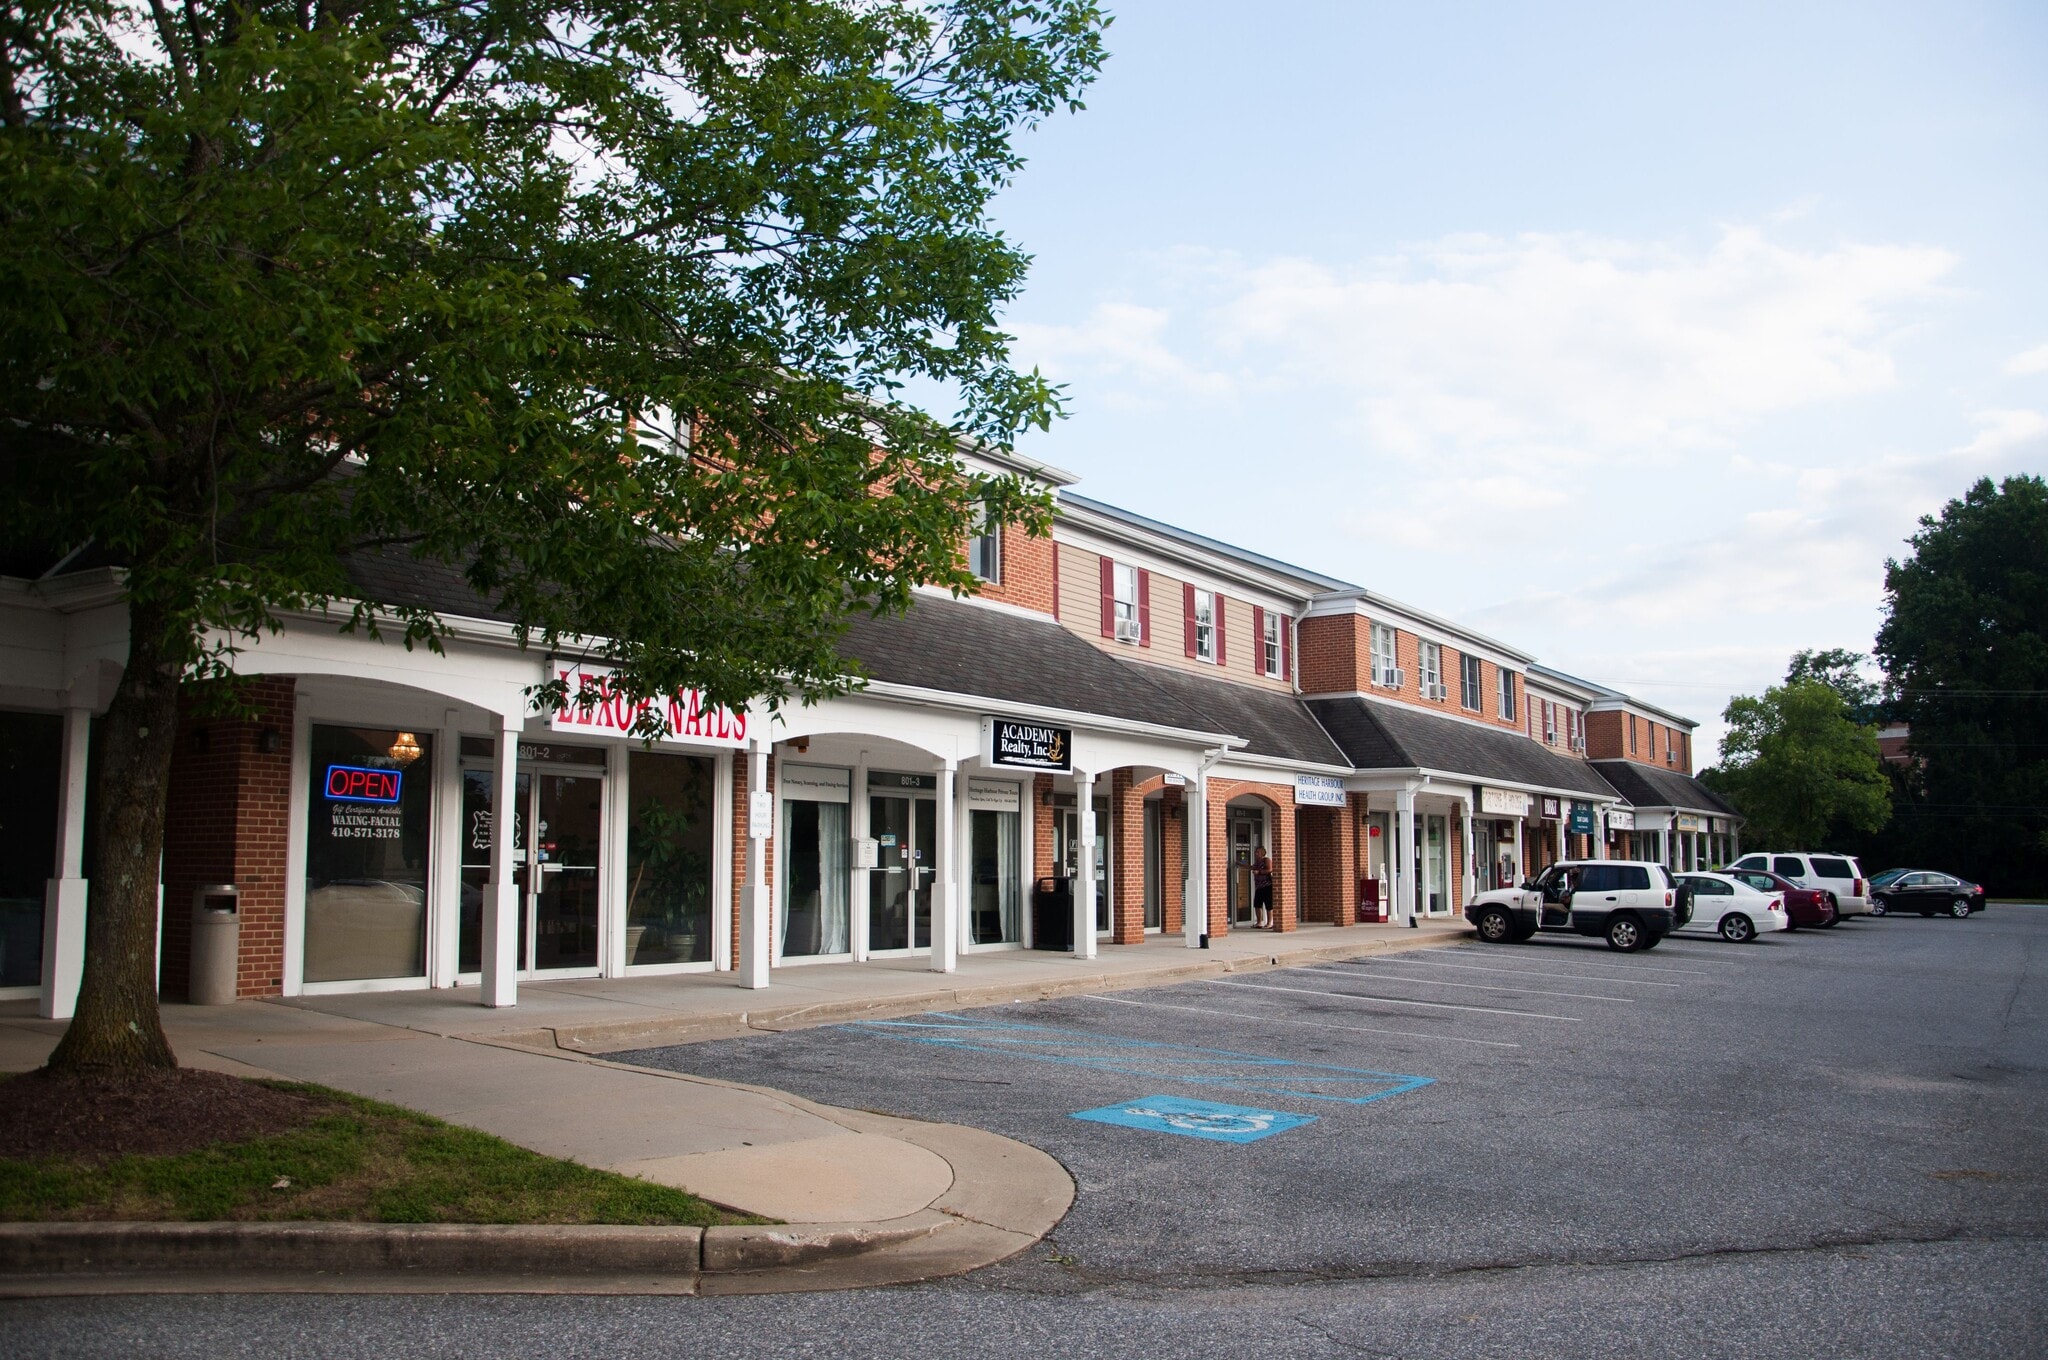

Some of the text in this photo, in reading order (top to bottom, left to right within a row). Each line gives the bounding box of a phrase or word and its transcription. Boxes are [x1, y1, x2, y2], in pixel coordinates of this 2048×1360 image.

[667, 685, 747, 741] NAILS
[1001, 724, 1054, 743] ACADEMY
[519, 745, 550, 758] 801-2
[1001, 738, 1050, 757] Realty, Inc.
[330, 770, 398, 798] OPEN
[901, 776, 920, 786] 801-3
[1297, 775, 1344, 789] HERITAGE HARBOUR
[1298, 790, 1317, 800] HEALTH
[1317, 791, 1335, 802] GROUP
[332, 815, 400, 827] WAXING-FACIAL
[331, 827, 400, 838] 410-571-3178
